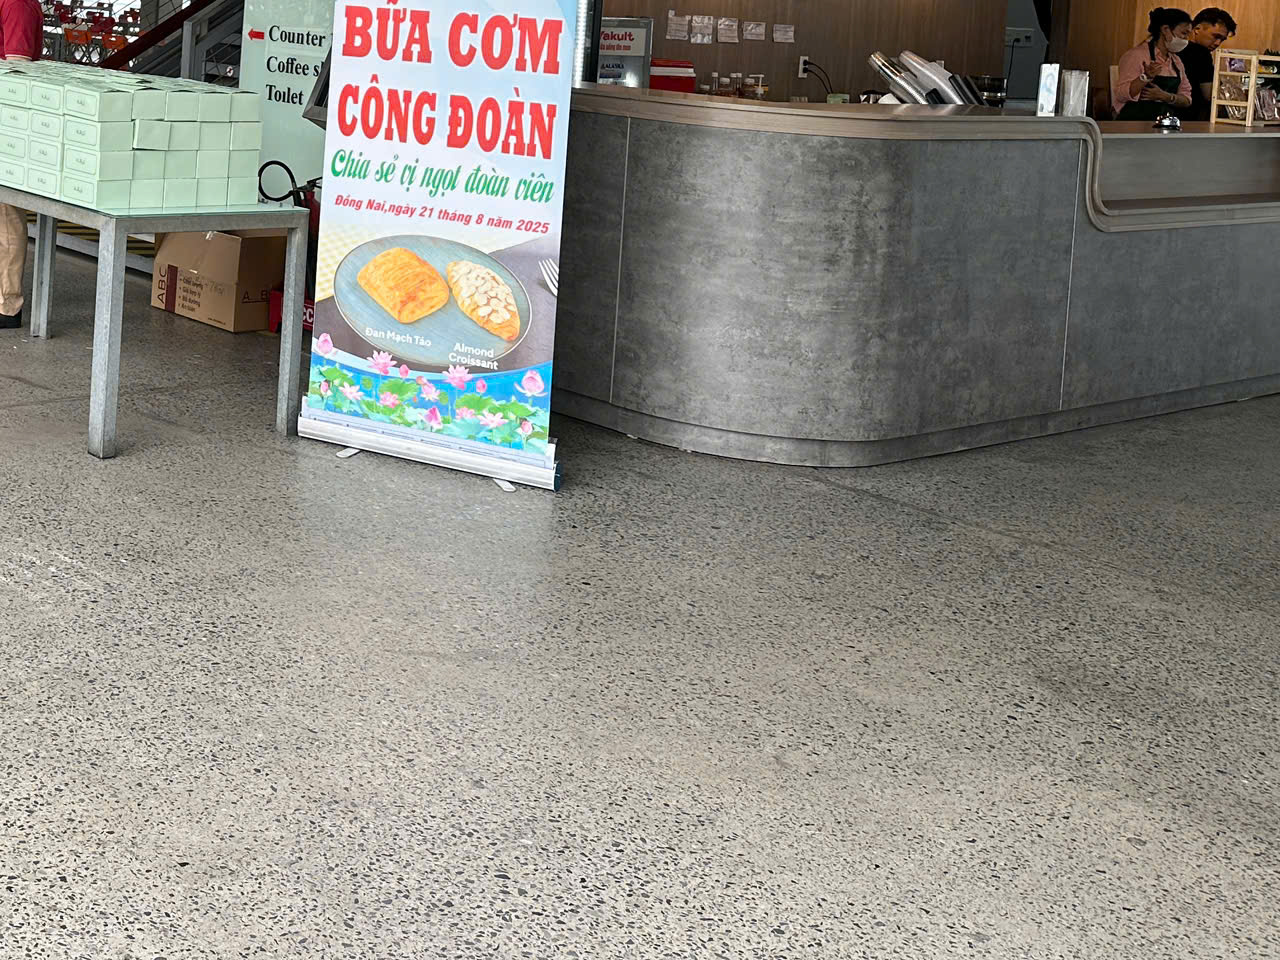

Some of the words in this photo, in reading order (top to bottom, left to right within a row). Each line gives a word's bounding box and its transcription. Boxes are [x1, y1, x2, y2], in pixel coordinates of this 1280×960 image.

[268, 25, 326, 47] Counter
[448, 12, 563, 75] CƠM
[266, 56, 309, 76] Coffee
[266, 84, 304, 106] Toilet
[337, 73, 437, 145] CÔNG
[447, 87, 557, 160] ĐOÀN
[331, 149, 370, 179] Chia
[375, 153, 399, 183] sẻ
[401, 157, 420, 192] vị
[420, 162, 461, 200] ngọt
[465, 165, 509, 197] đoàn
[514, 173, 554, 203] viên
[335, 194, 362, 211] Đồng
[419, 206, 433, 218] 21
[437, 208, 472, 226] tháng
[475, 214, 484, 225] 8
[487, 215, 513, 229] năm
[515, 218, 550, 234] 2025
[365, 327, 385, 338] Đan
[386, 330, 414, 345] Mạch
[414, 333, 432, 347] Táo
[448, 352, 499, 370] Croissant
[453, 342, 494, 359] Almond
